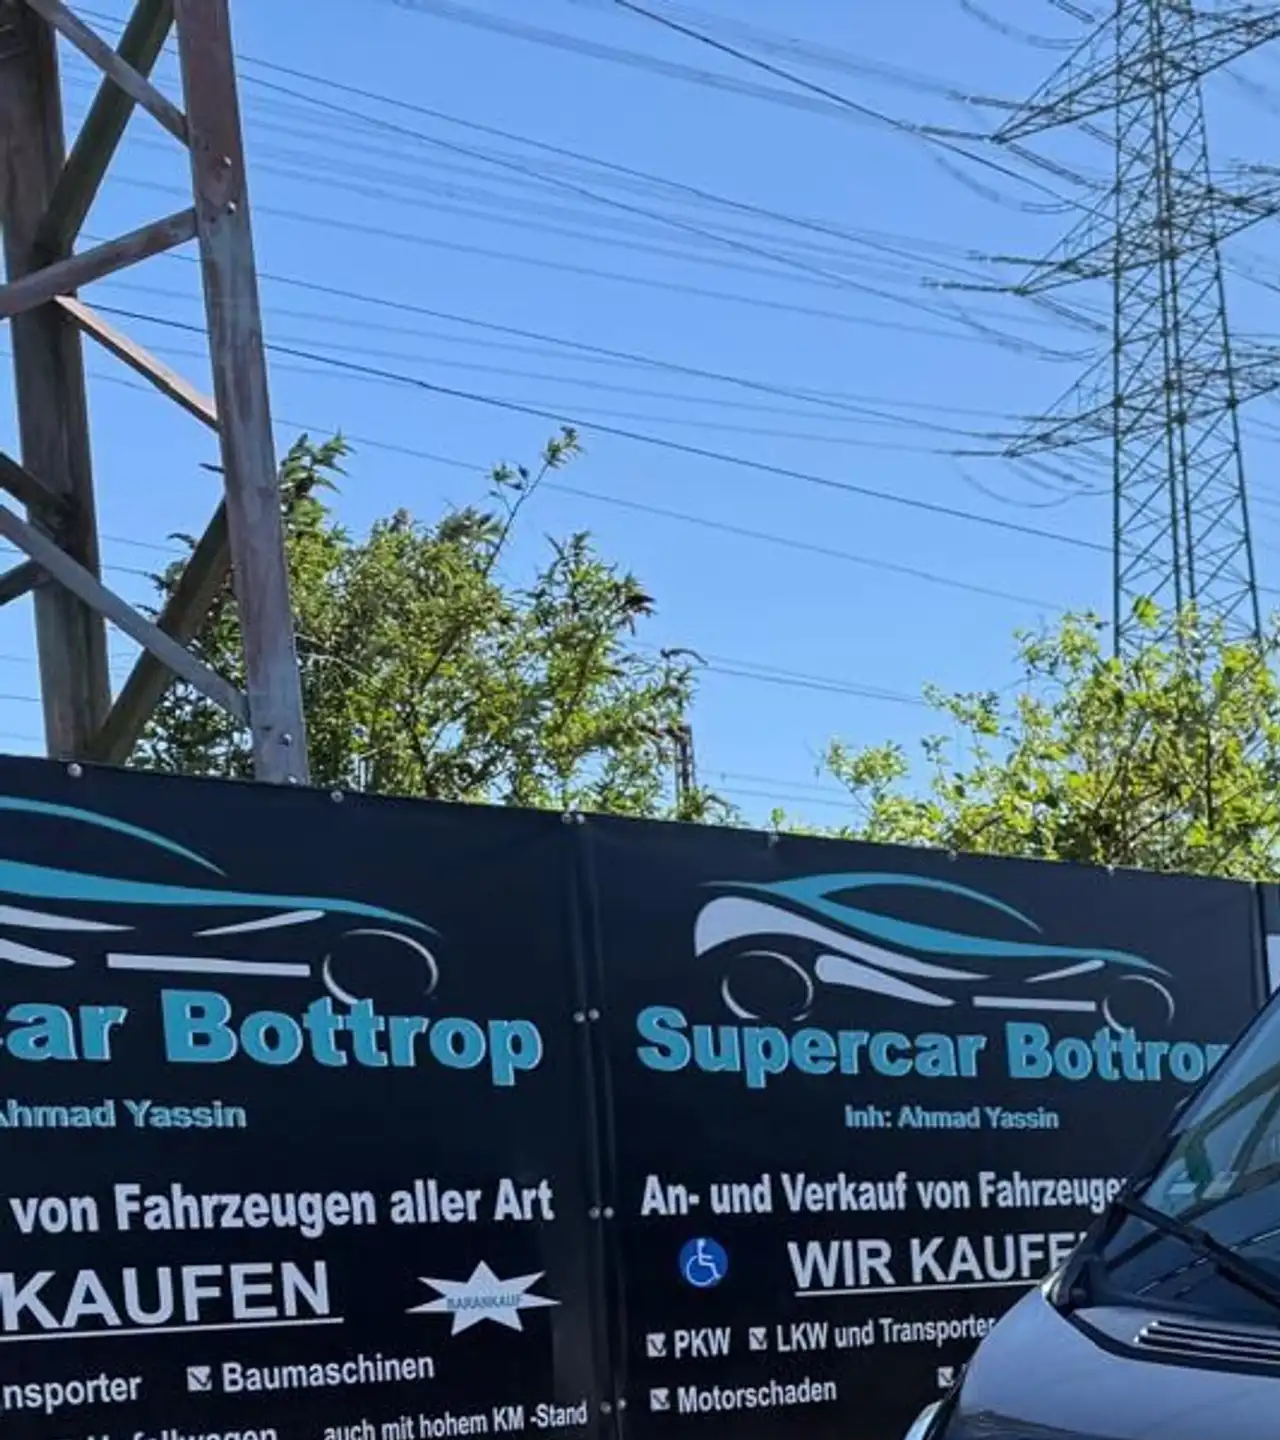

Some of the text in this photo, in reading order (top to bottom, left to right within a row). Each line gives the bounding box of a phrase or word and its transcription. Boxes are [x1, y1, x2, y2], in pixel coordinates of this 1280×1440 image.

[0, 989, 543, 1086] ar Bottrop
[636, 1005, 986, 1088] Supercar
[123, 1099, 247, 1128] Yassin
[845, 1104, 1059, 1130] Inh: Ahmad Yassin
[9, 1178, 555, 1238] von Fahrzeugen aller Art
[641, 1170, 1127, 1216] An- und Verkauf von Fahrzeuge
[787, 1231, 1087, 1289] WIR KAUFE
[0, 1260, 330, 1332] KAUFEN
[674, 1328, 731, 1358] PKW
[776, 1322, 829, 1353] LKW
[834, 1321, 874, 1349] und
[0, 1372, 143, 1415] nsporter
[222, 1354, 434, 1393] Baumaschinen
[677, 1377, 837, 1414] Motorschaden
[419, 1411, 488, 1440] hohem
[492, 1406, 525, 1433] KM
[530, 1400, 588, 1429] -Stand
